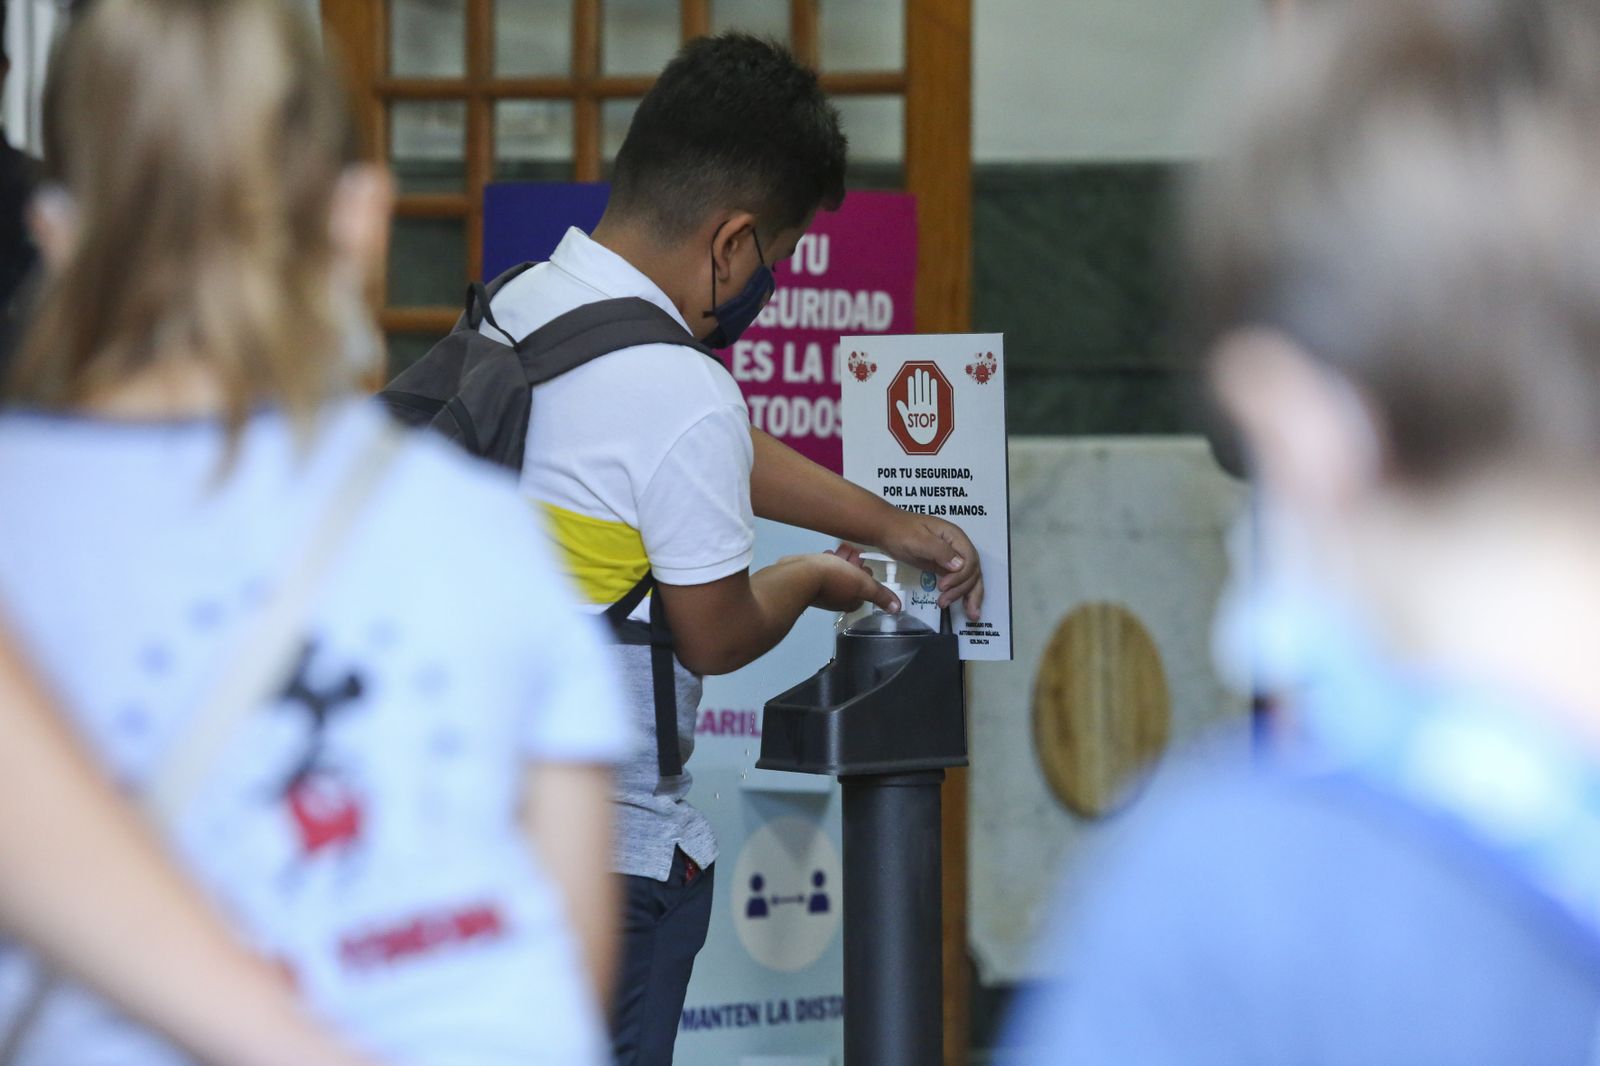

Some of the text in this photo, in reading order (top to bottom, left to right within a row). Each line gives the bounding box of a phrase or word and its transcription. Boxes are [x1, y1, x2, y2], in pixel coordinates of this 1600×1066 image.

[791, 233, 830, 276] TU
[751, 286, 894, 332] GURIDAD
[733, 340, 775, 383] ES
[782, 342, 825, 384] LA
[907, 412, 937, 429] STOP
[877, 467, 974, 481] POR TU SEGURIDAD,
[883, 486, 968, 498] POR LA NUESTRA.
[928, 504, 947, 516] LAS
[949, 504, 988, 516] MANOS.
[696, 708, 762, 737] ARIL
[681, 1002, 762, 1032] MANTEN
[766, 998, 791, 1025] LA
